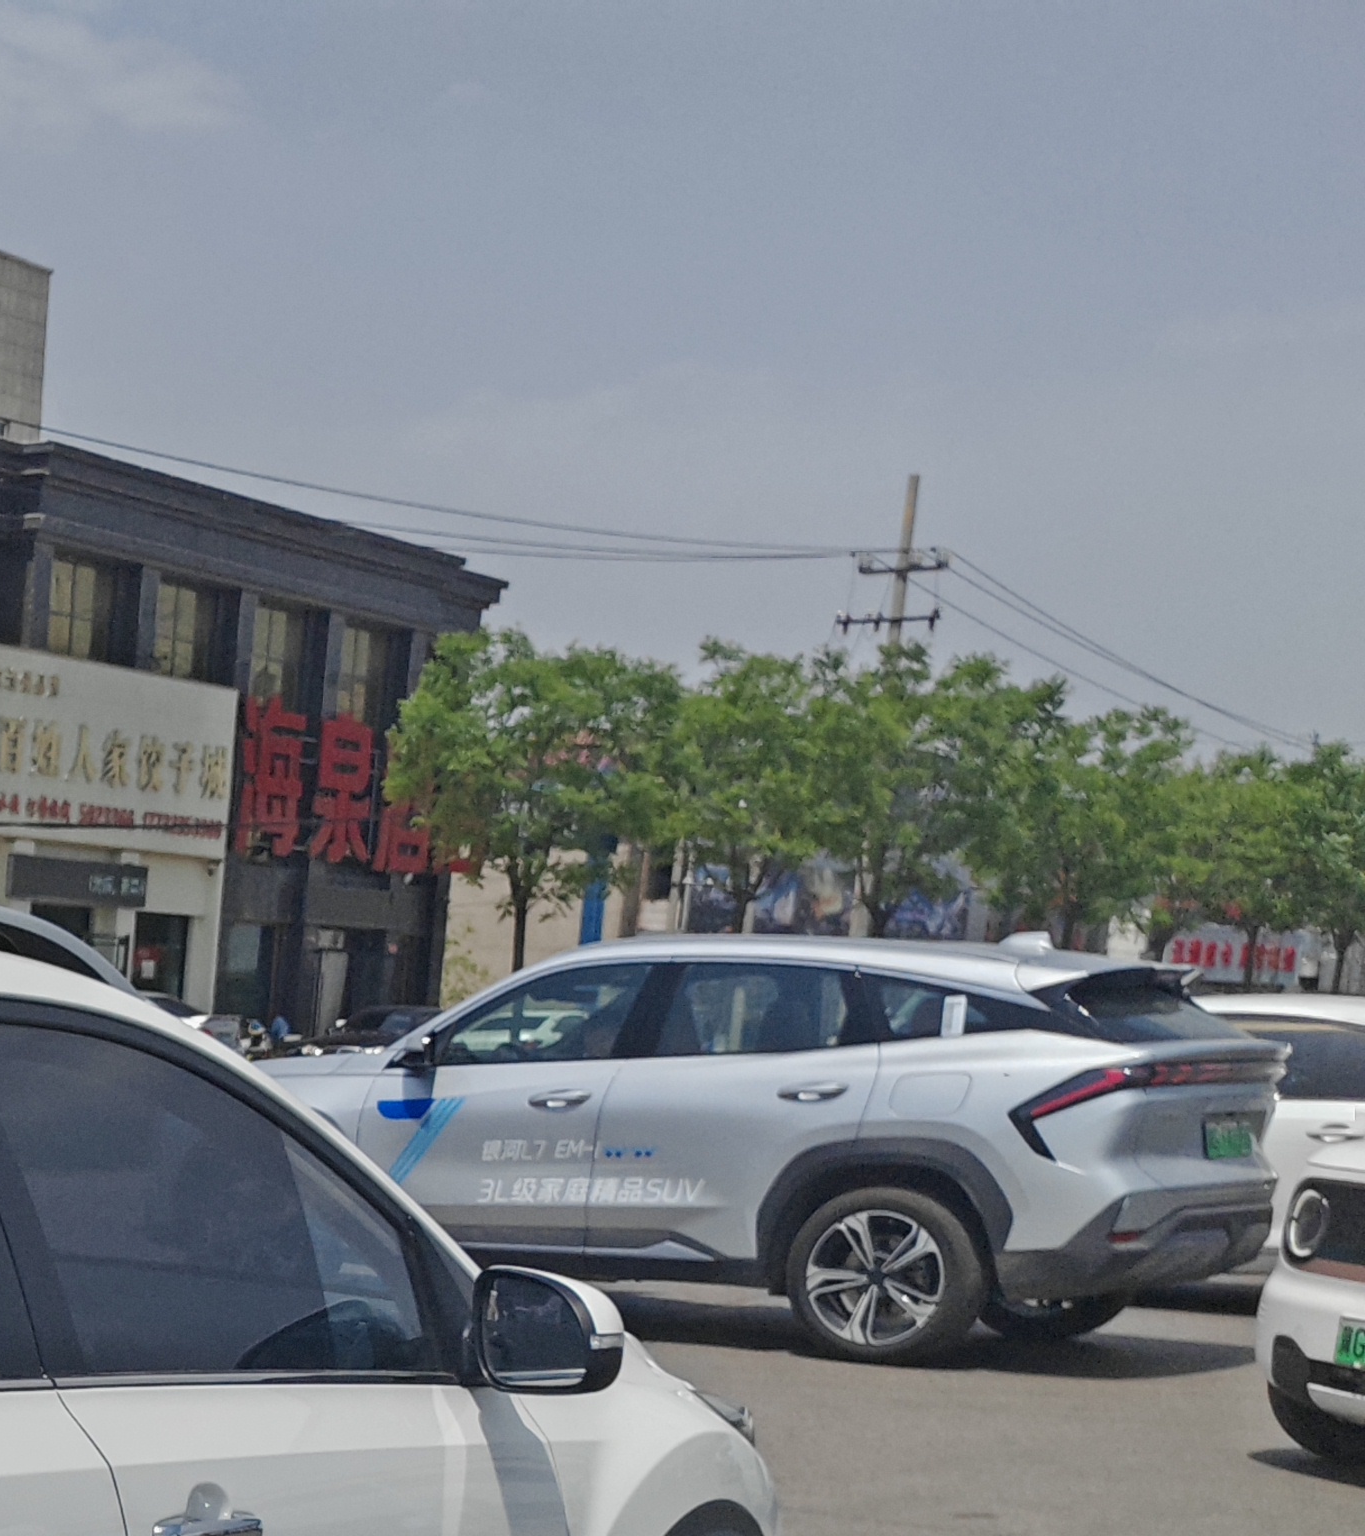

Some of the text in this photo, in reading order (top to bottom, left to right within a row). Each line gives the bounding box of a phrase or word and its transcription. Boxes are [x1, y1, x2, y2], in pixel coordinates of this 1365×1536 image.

[477, 1177, 706, 1203] 3L级家庭精品SUV
